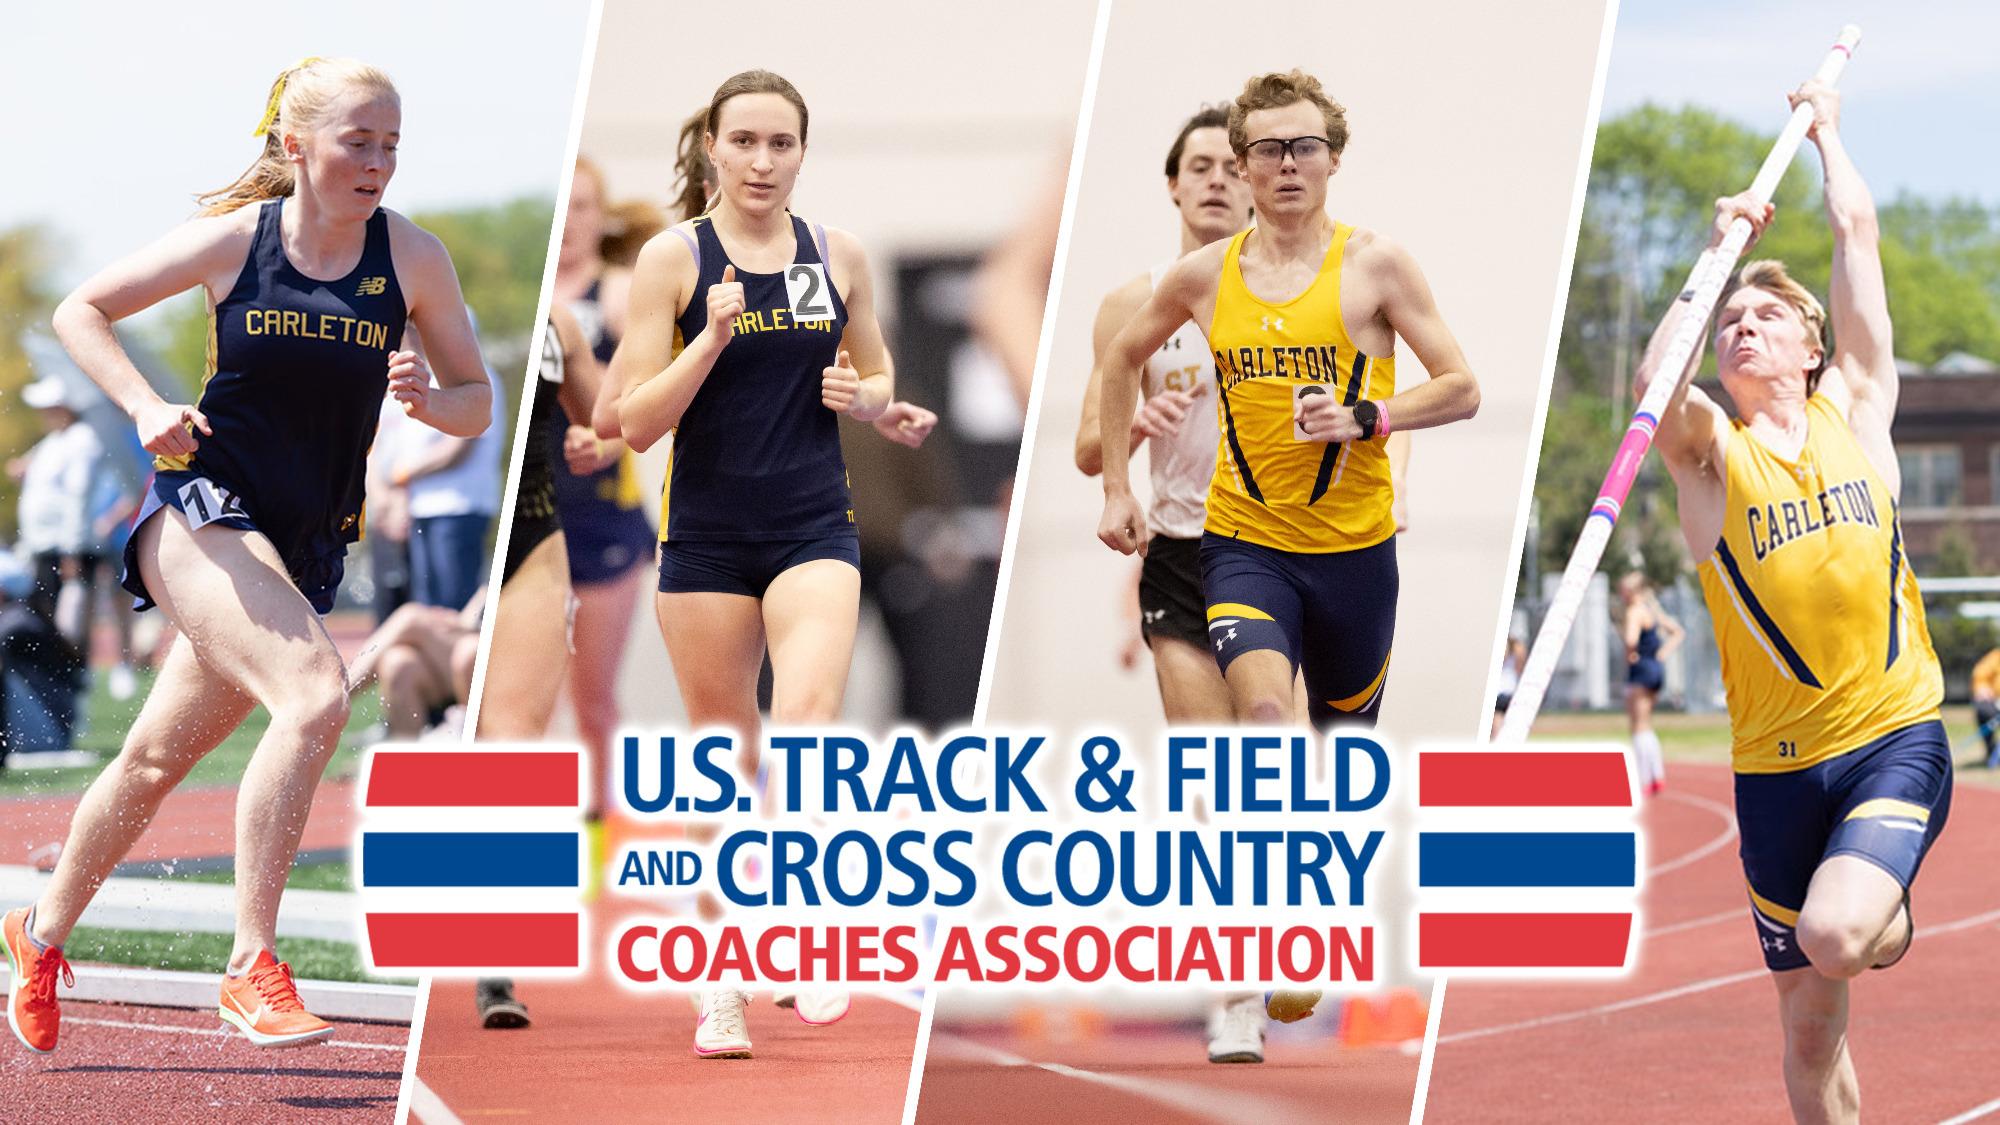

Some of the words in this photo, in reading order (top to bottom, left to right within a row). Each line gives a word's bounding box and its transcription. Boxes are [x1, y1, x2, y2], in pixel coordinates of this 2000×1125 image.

[788, 265, 828, 315] 2
[245, 309, 388, 350] CARLETON
[731, 308, 831, 334] ARLEN
[1747, 479, 1880, 562] CARLETON
[1778, 740, 1797, 758] 31
